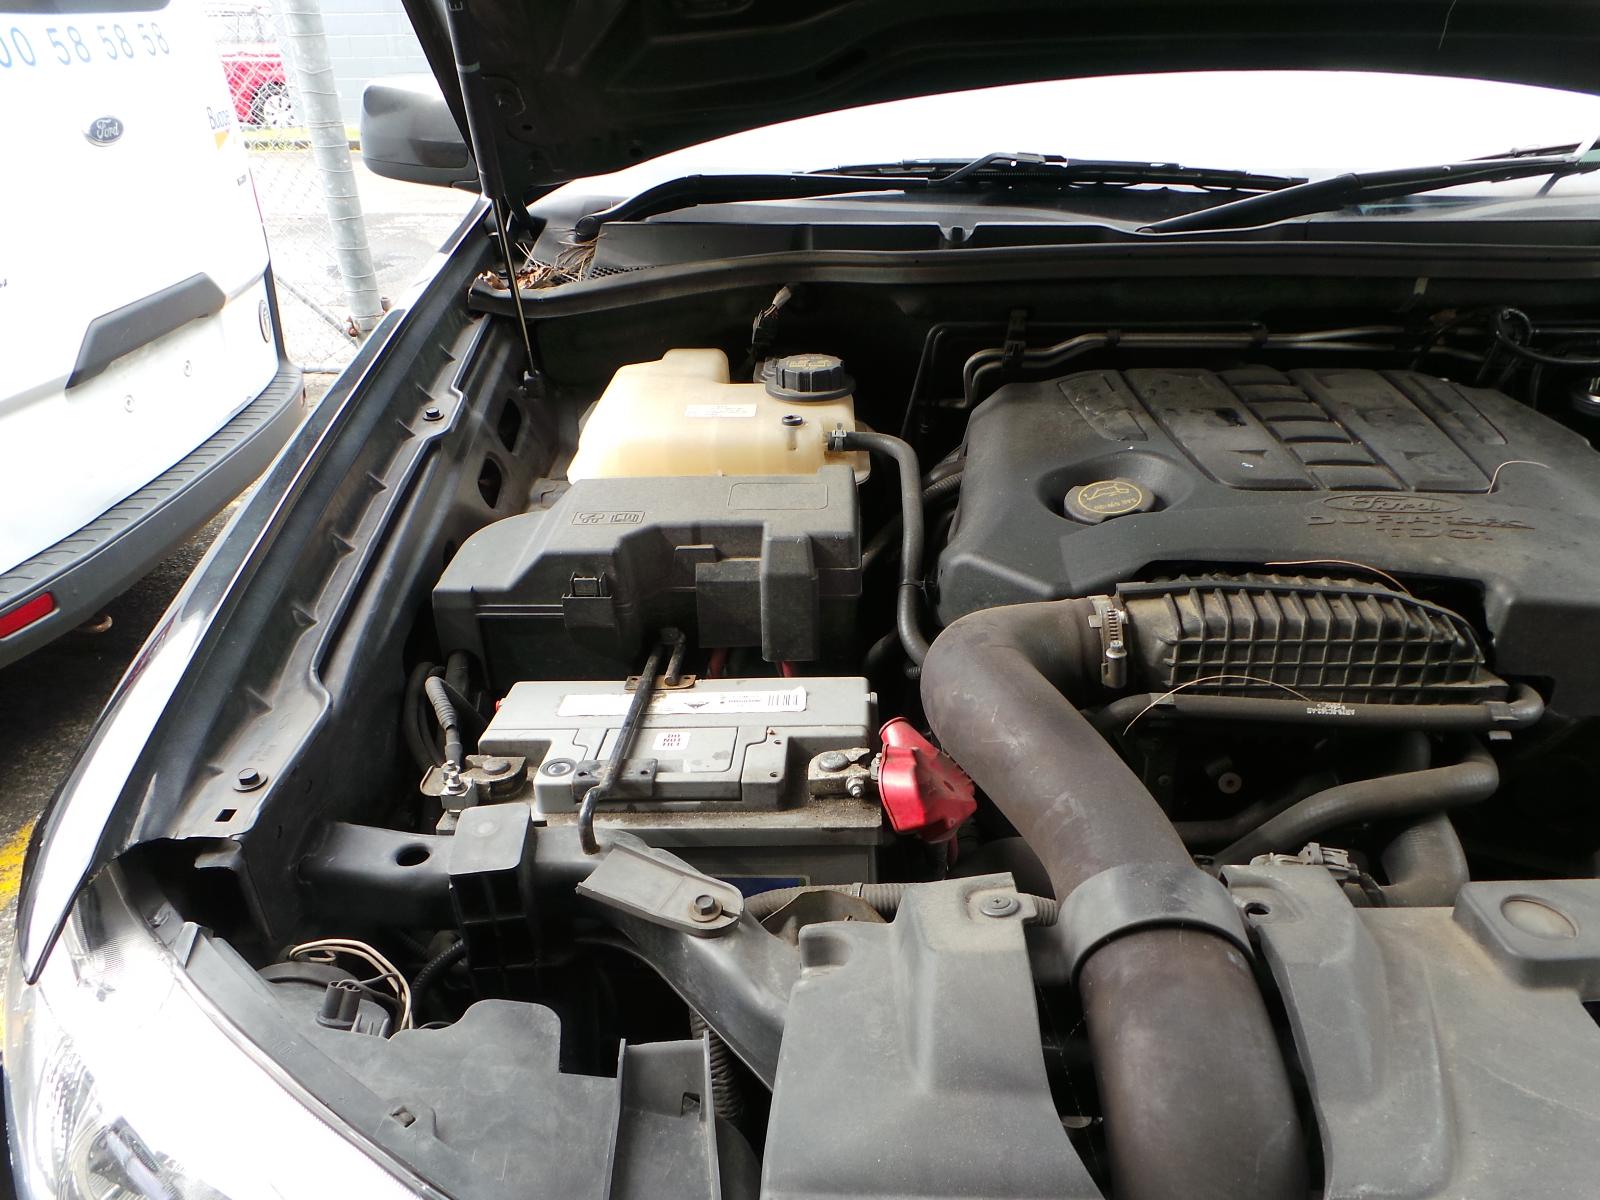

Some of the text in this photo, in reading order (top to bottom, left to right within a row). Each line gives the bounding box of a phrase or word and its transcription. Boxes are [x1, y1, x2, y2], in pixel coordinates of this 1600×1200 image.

[46, 26, 91, 65] 58
[97, 24, 134, 60] 58
[137, 22, 169, 56] 58
[96, 118, 119, 139] Ford
[1351, 496, 1441, 512] Ford
